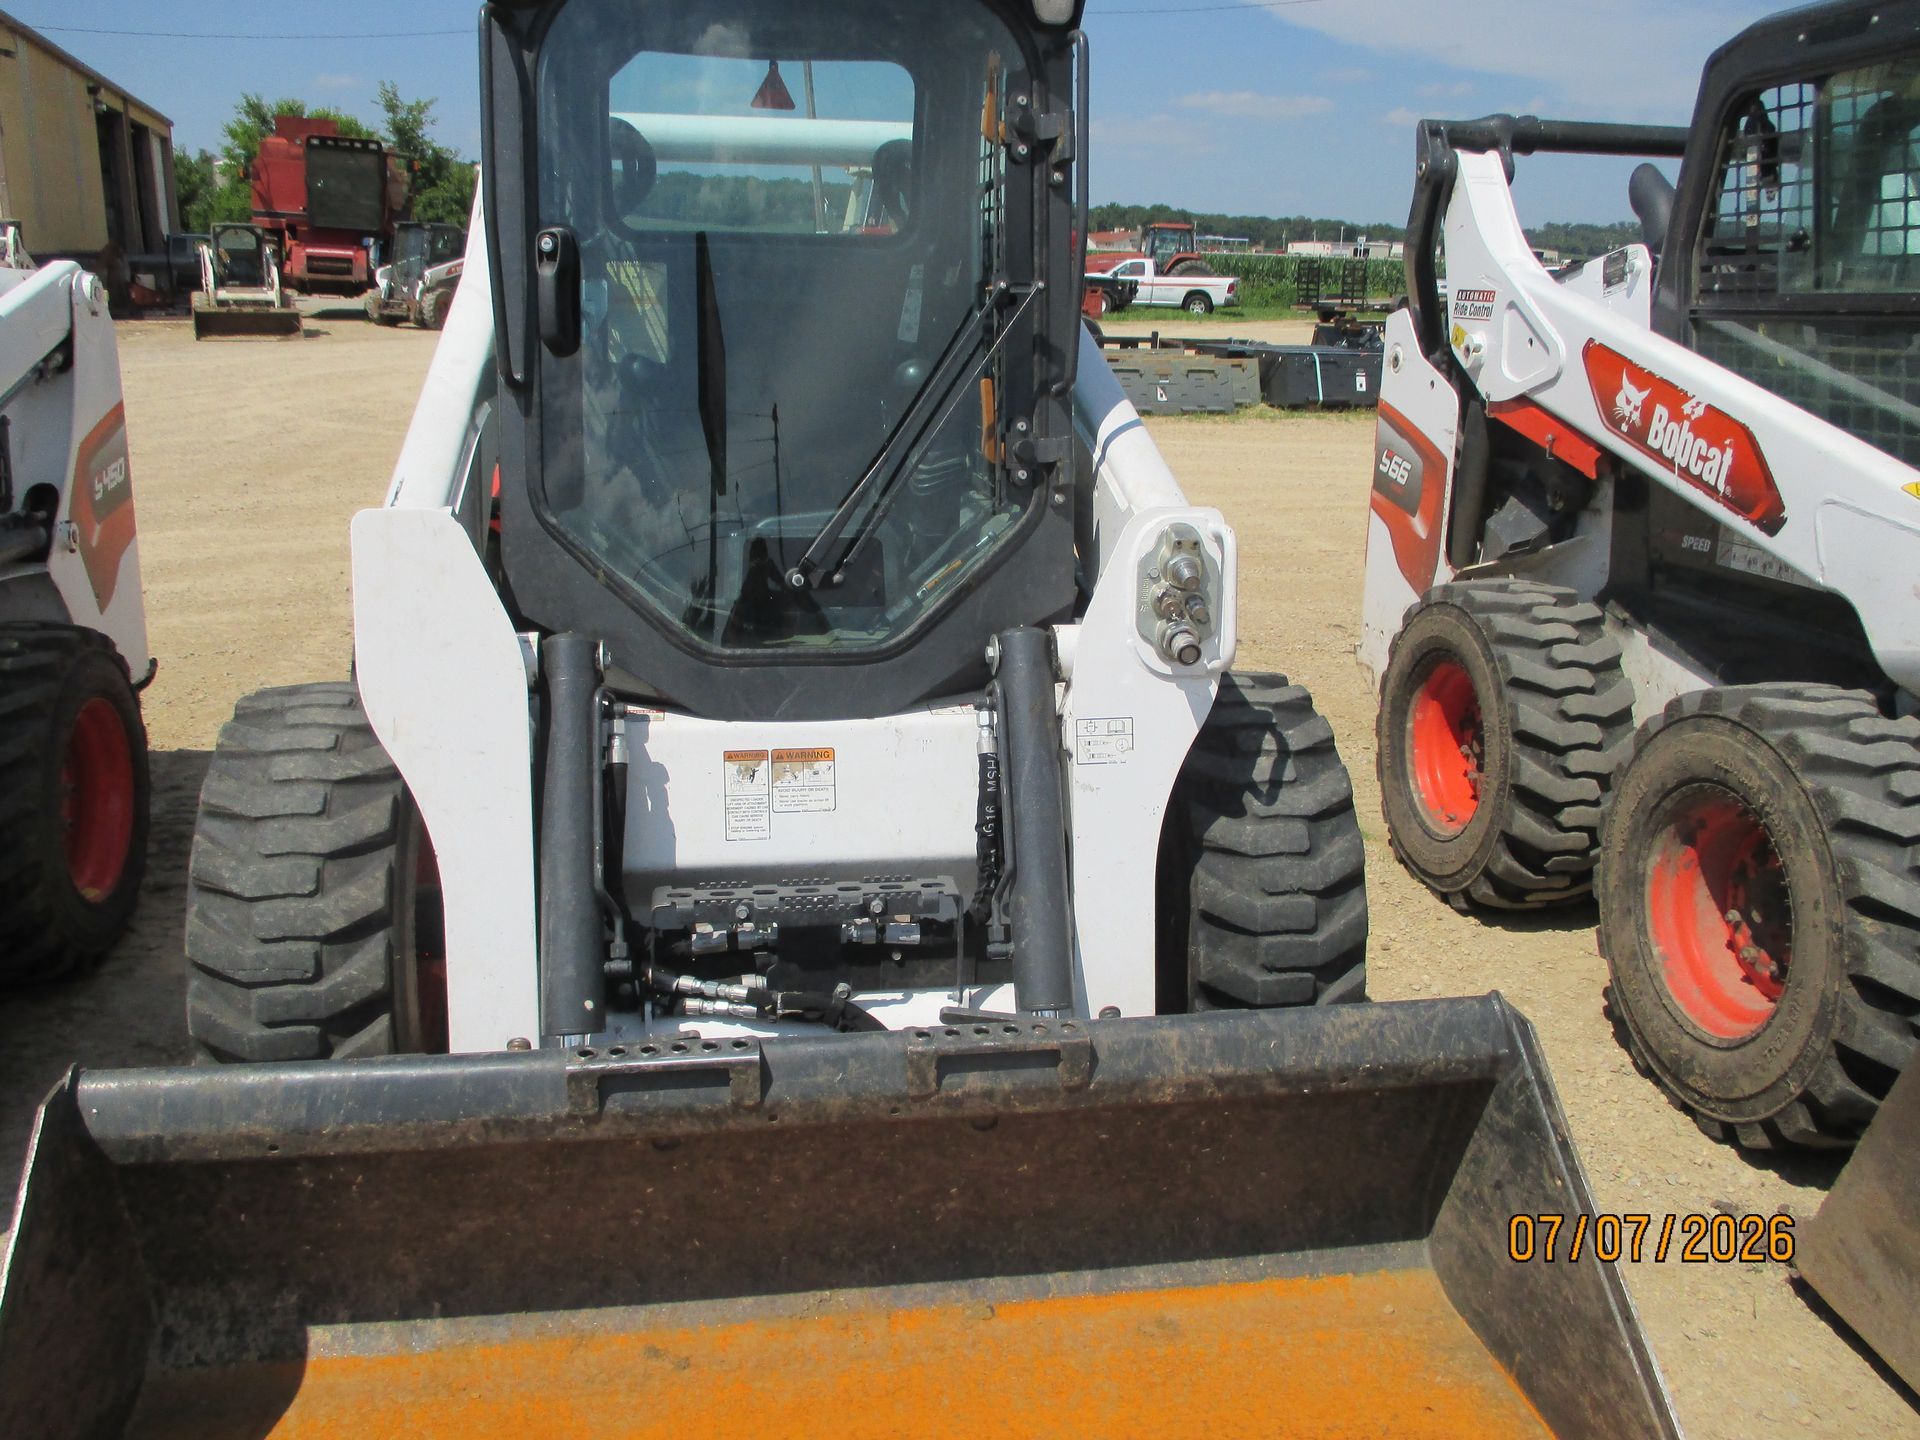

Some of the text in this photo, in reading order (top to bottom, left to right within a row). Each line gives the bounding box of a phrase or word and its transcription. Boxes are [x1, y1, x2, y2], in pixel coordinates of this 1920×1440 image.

[1457, 290, 1495, 302] AUTOMATIC
[1453, 302, 1494, 317] Ride Control
[1646, 403, 1734, 495] Bobcat
[1379, 449, 1412, 485] S66
[95, 457, 125, 500] S450
[1681, 535, 1712, 552] SPEED
[733, 752, 765, 760] WARNING
[785, 750, 830, 760] WARNING
